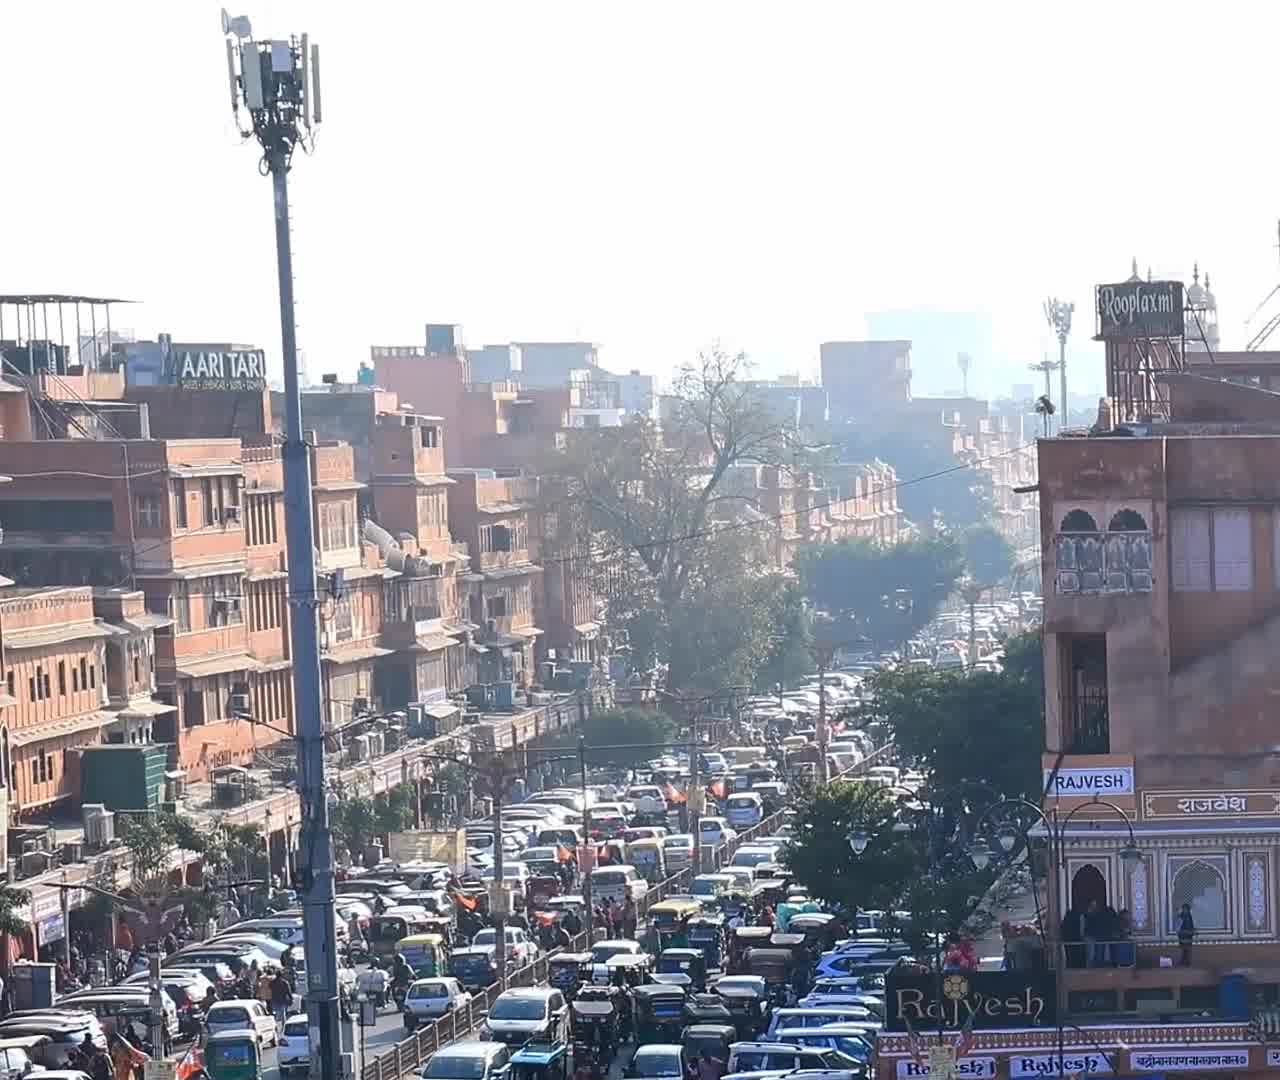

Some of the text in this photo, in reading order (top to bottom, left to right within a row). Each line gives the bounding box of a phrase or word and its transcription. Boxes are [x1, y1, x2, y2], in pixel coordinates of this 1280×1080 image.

[1101, 287, 1174, 326] Rooplaxmi
[181, 352, 265, 378] AARI TARI
[1055, 775, 1124, 789] RAJVESH
[1176, 795, 1248, 814] राजवेश
[896, 985, 1045, 1027] Rajvesh
[906, 1061, 985, 1076] Raesh
